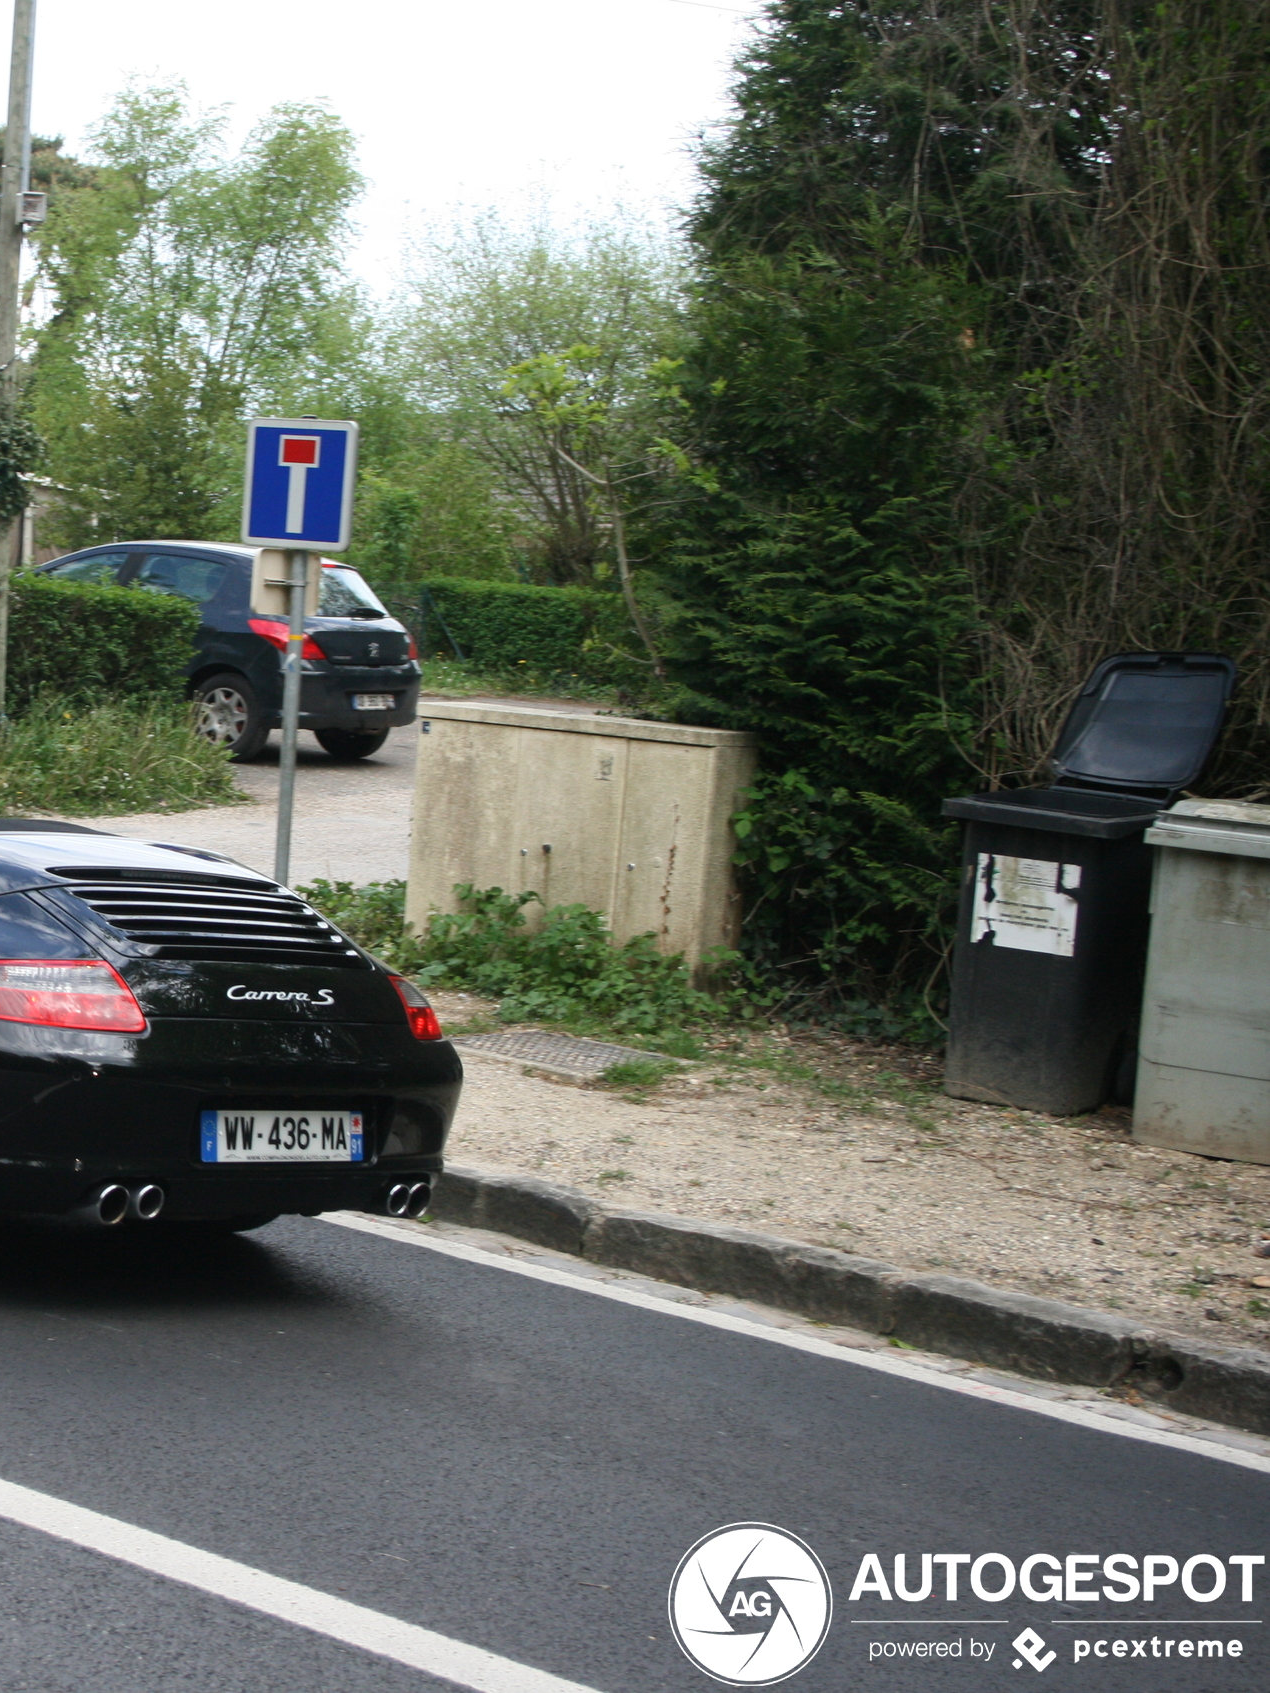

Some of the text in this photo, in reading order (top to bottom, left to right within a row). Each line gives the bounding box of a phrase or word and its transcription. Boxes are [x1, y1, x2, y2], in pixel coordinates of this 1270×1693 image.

[226, 984, 335, 1006] Carrera S
[223, 1116, 348, 1151] WW-436-MA
[351, 1137, 363, 1154] 91
